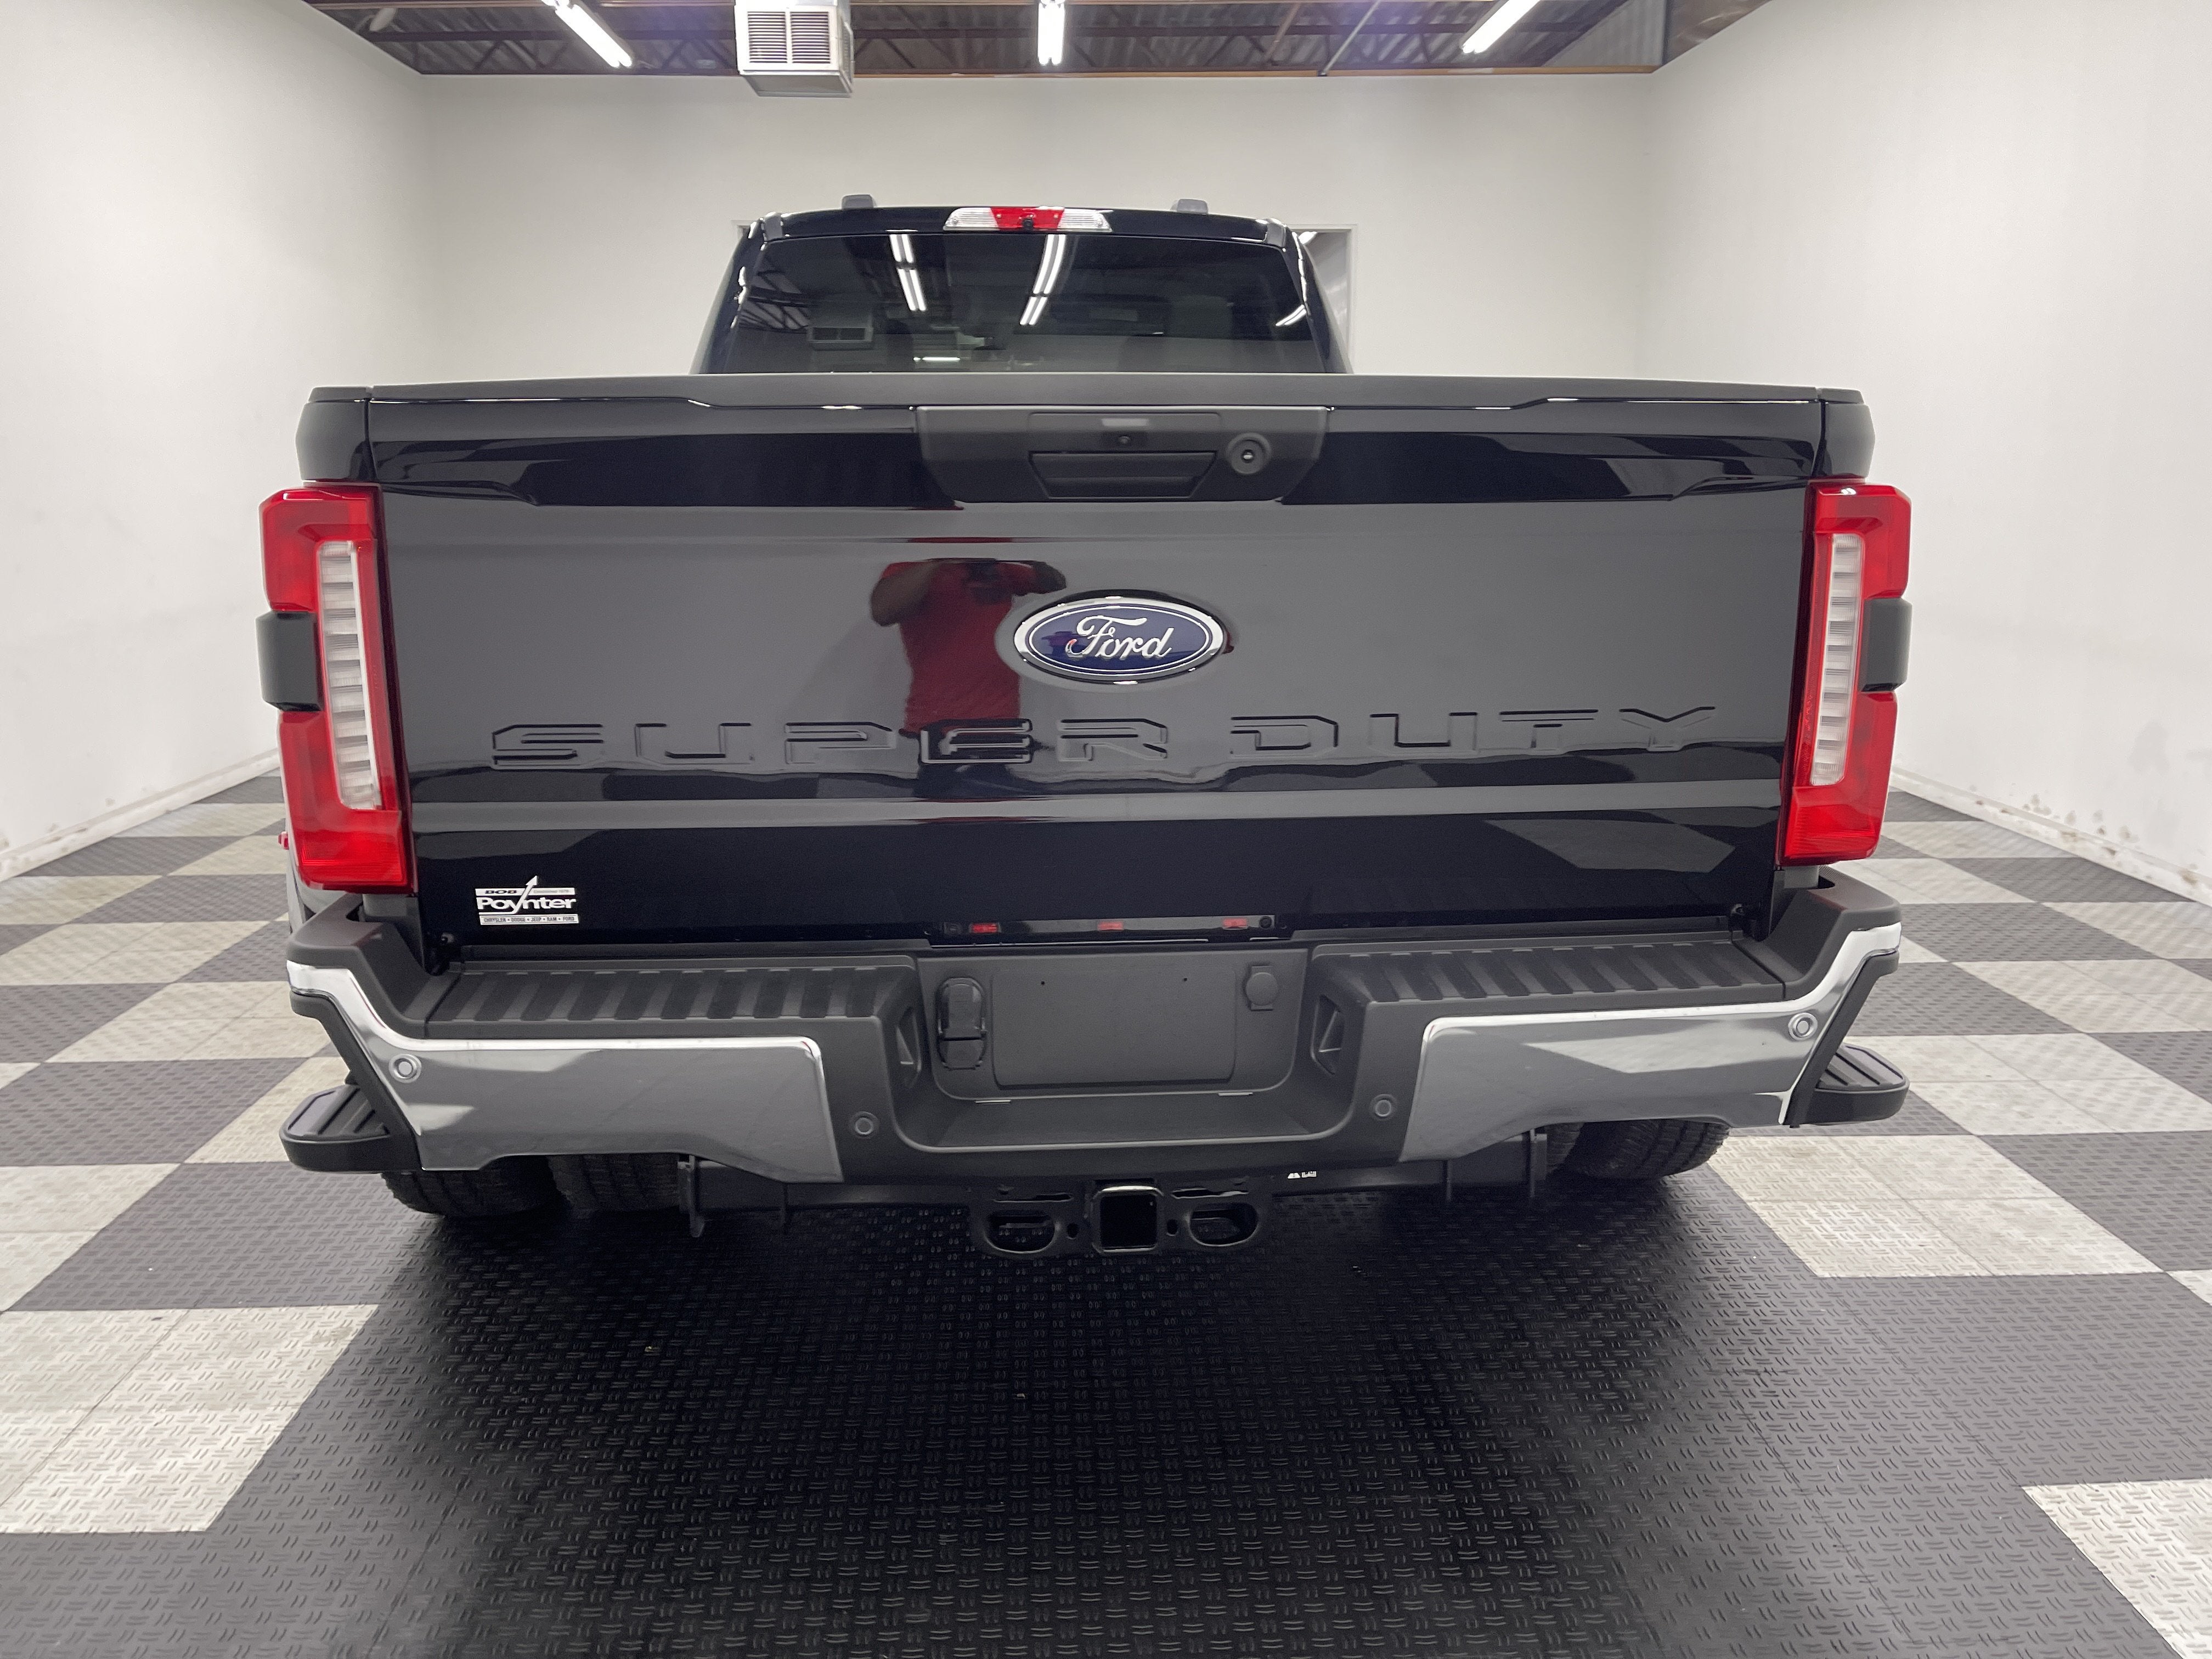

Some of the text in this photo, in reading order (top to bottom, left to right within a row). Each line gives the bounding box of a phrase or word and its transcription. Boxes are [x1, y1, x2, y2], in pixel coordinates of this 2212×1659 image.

[1065, 614, 1175, 661] Ford
[492, 706, 1716, 766] SUPER DUTY
[476, 896, 577, 914] Poynter
